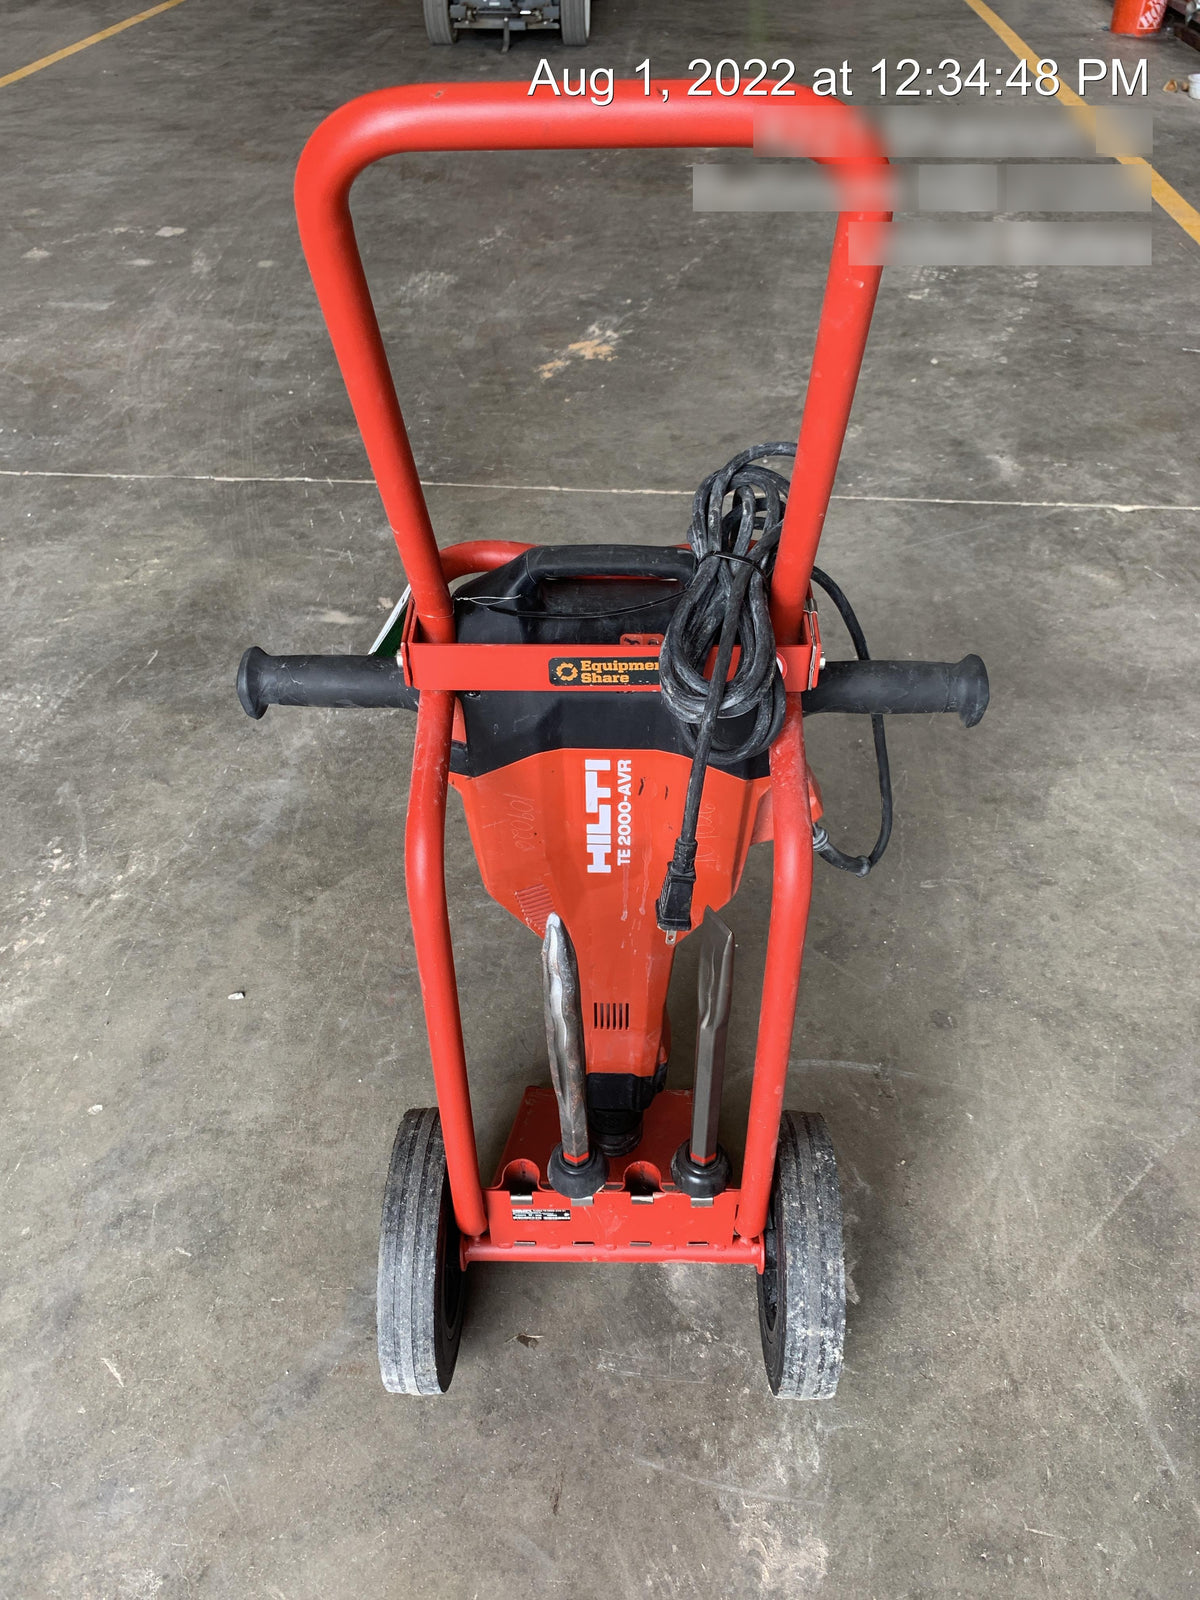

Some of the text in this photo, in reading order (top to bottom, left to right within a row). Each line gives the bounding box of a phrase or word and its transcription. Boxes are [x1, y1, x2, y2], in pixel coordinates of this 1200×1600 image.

[580, 672, 630, 683] Share
[585, 759, 612, 874] HILTI
[617, 759, 632, 867] TE 2000-AVR
